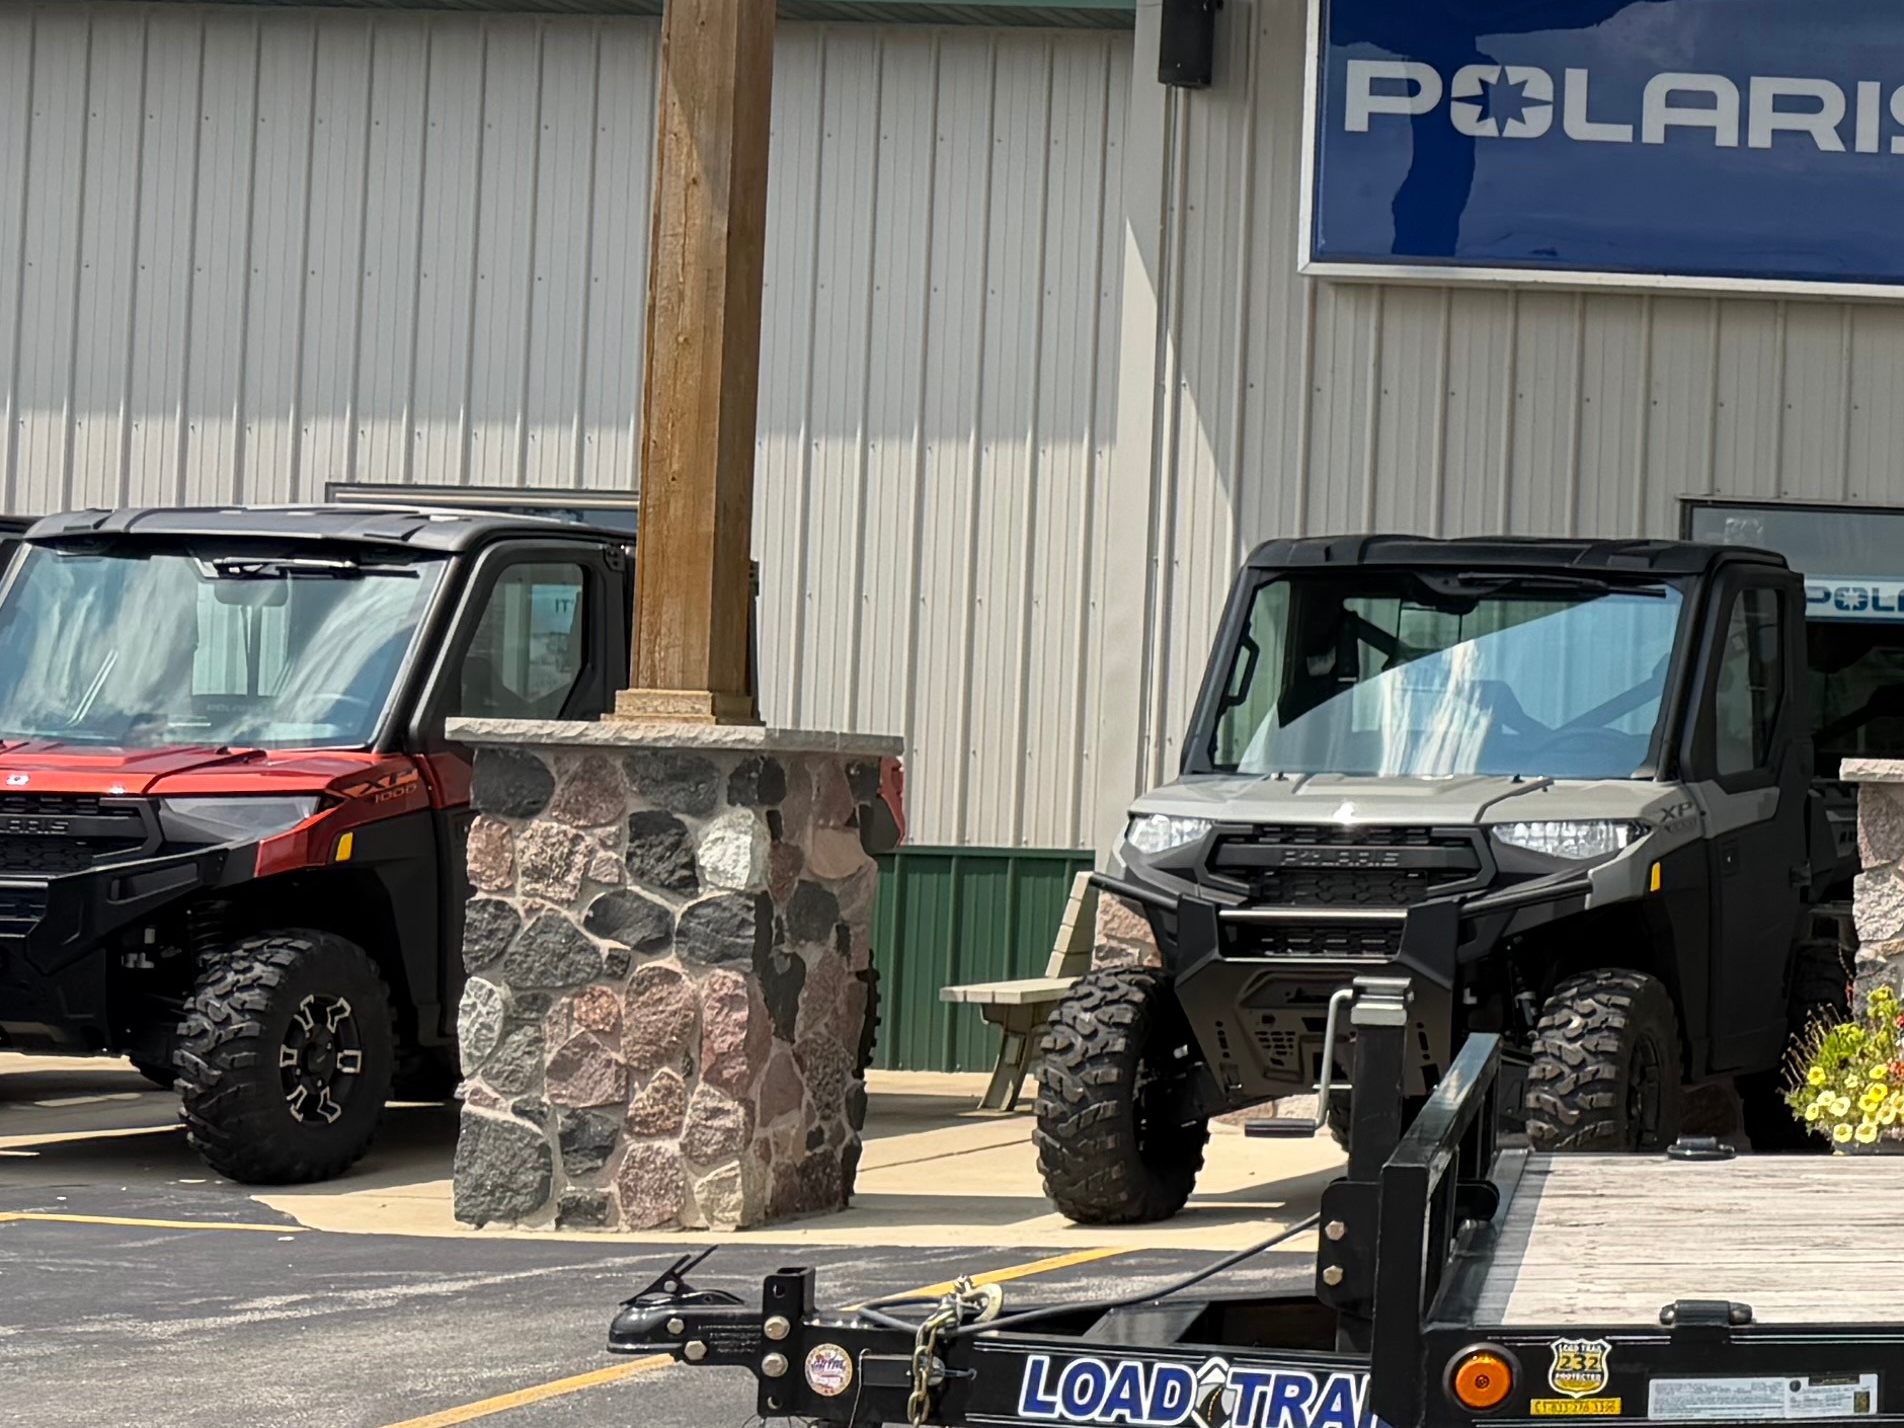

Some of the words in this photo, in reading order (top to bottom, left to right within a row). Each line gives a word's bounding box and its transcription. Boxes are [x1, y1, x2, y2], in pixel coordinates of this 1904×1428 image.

[1660, 801, 1693, 823] XP
[1558, 1353, 1599, 1372] 232
[1016, 1353, 1198, 1428] LOAD
